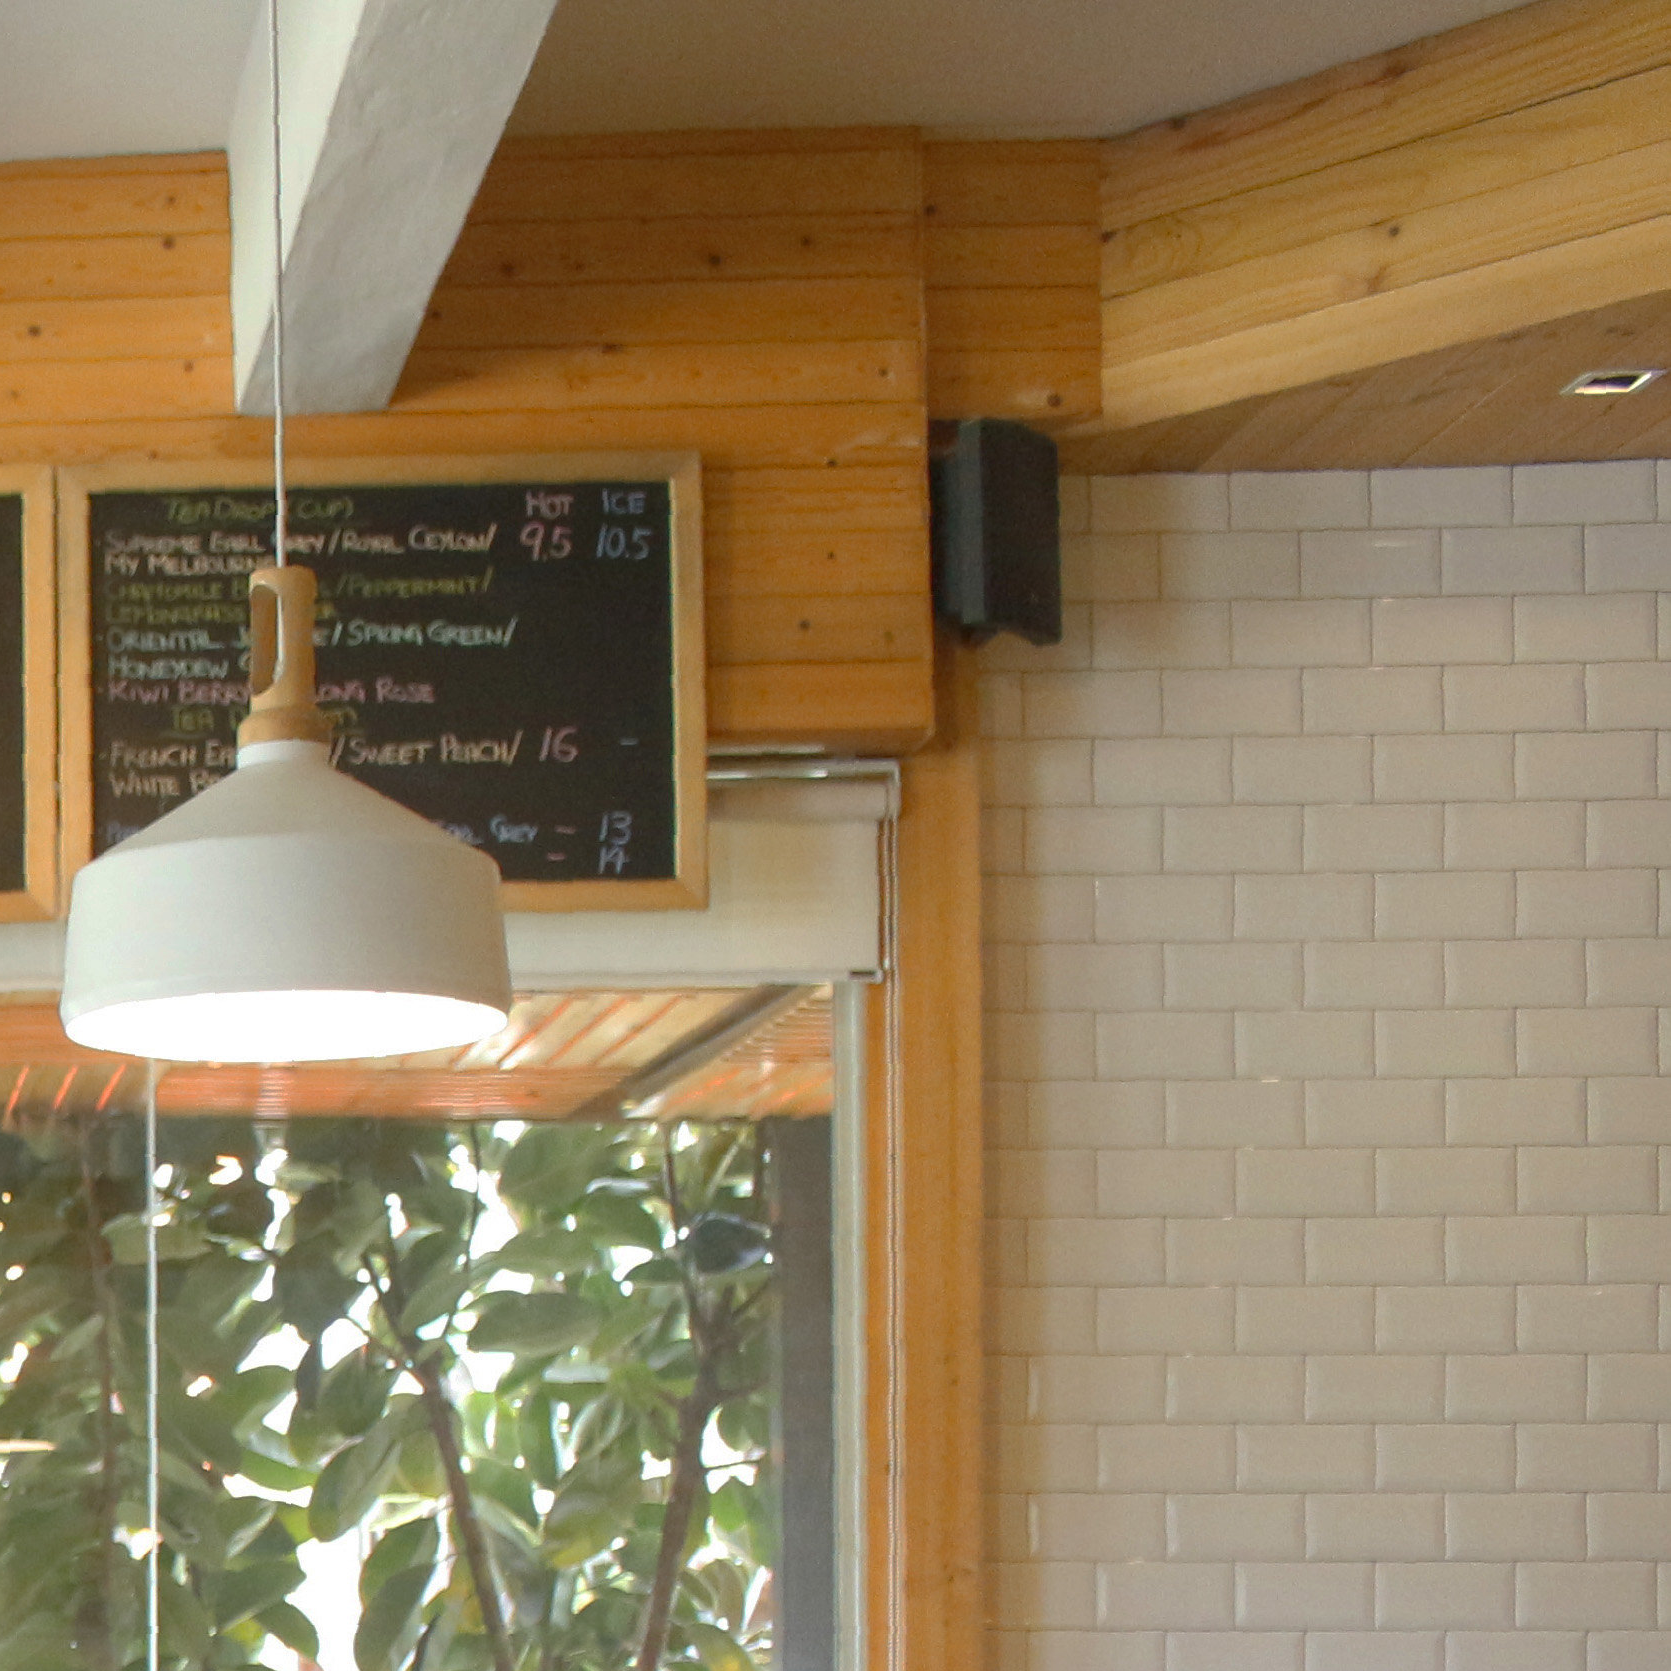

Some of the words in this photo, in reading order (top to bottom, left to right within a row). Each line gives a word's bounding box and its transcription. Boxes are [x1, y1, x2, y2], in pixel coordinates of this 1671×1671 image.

[525, 490, 575, 520] HOT
[602, 487, 647, 516] ICE
[520, 521, 574, 562] 9.5
[596, 522, 652, 560] 10.5
[539, 725, 580, 763] 16
[599, 811, 633, 846] 13
